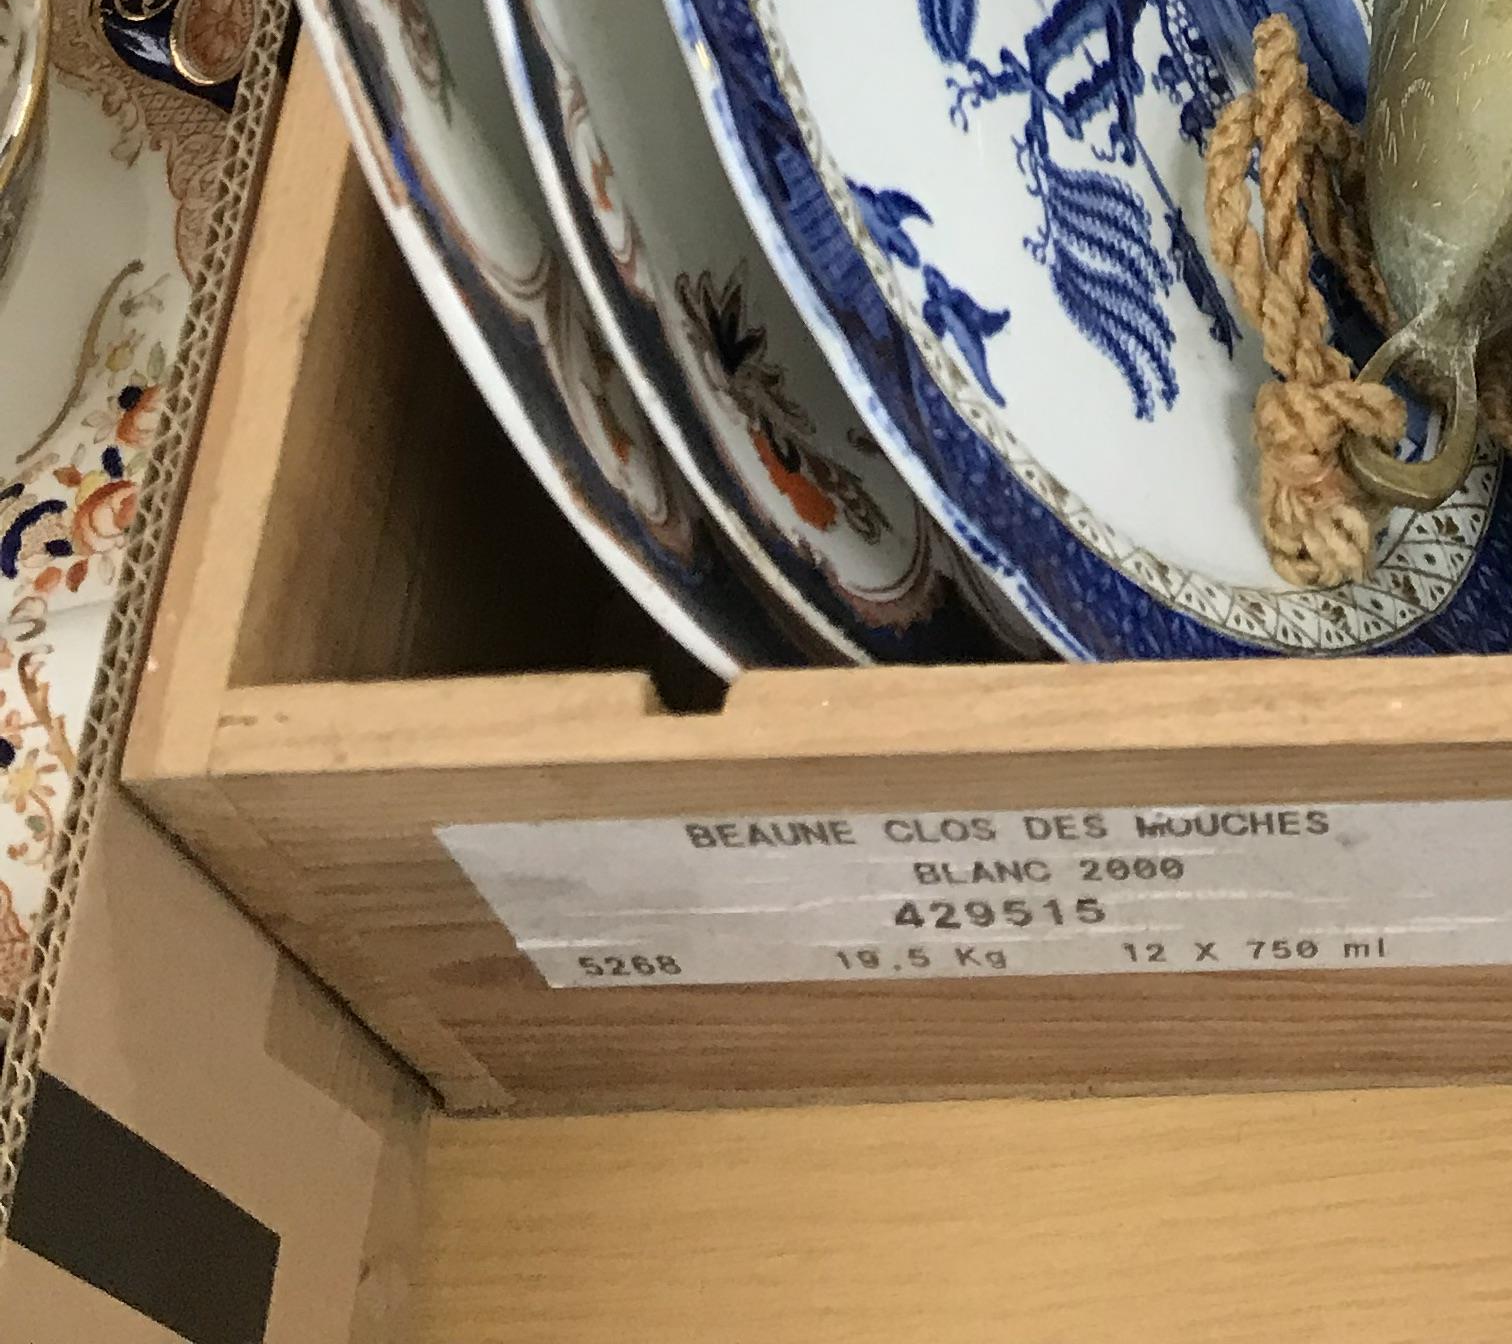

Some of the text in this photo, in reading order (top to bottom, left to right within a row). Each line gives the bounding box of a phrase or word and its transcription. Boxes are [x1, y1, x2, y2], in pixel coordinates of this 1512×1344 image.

[685, 810, 1331, 849] BEAUNE CLOS DES MOUCHES
[913, 856, 1186, 886] BLANC 2000
[894, 896, 1107, 929] 429515
[836, 944, 1008, 972] 19.5 Kg
[1121, 936, 1387, 963] 12 X 750 ml
[577, 954, 683, 977] 5268
